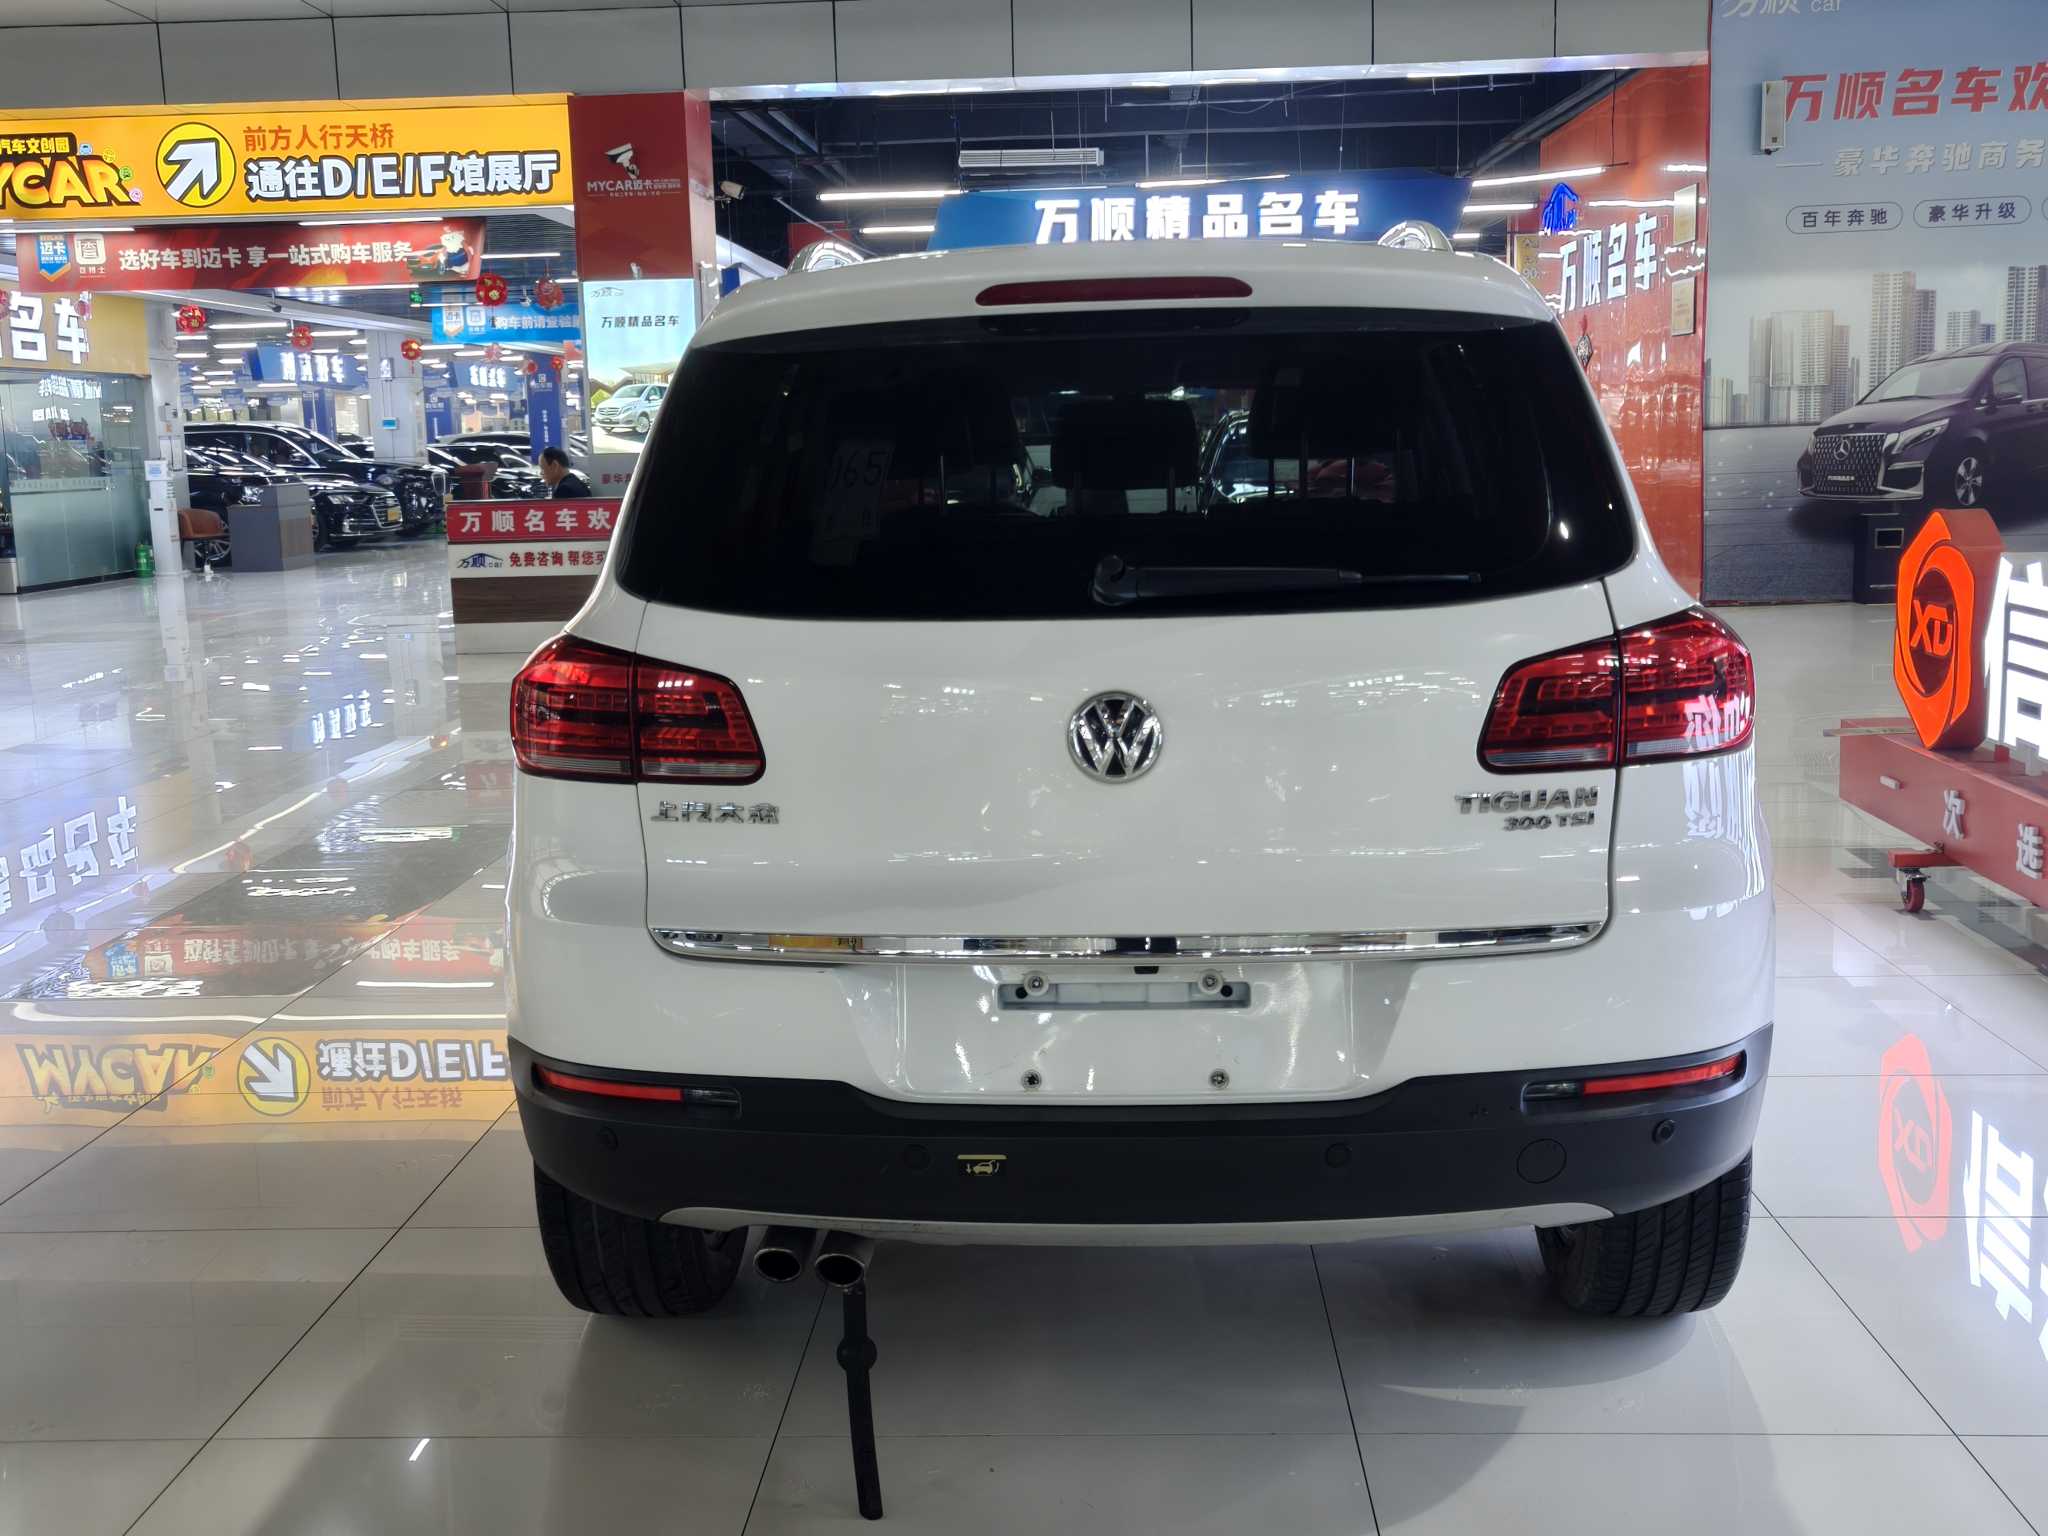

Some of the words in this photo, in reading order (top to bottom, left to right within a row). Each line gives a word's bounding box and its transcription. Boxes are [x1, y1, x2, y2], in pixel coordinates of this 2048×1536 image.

[243, 122, 394, 152] 前方人行天桥
[1034, 190, 1359, 245] 万顺精品名车
[1801, 207, 1889, 229] 百年奔驰
[1928, 201, 2016, 223] 豪华升级
[40, 241, 67, 255] 迈卡
[118, 244, 242, 272] 选好车到迈卡
[246, 240, 413, 268] 享一站式购车服务
[1559, 212, 1658, 314] 万顺名车
[601, 314, 680, 329] 万顺精品名车
[459, 507, 612, 533] 万顺名车欢
[509, 551, 564, 568] 免费咨询
[1454, 785, 1601, 815] TIGUAN
[1502, 815, 1552, 832] 300
[1556, 811, 1595, 828] TSI
